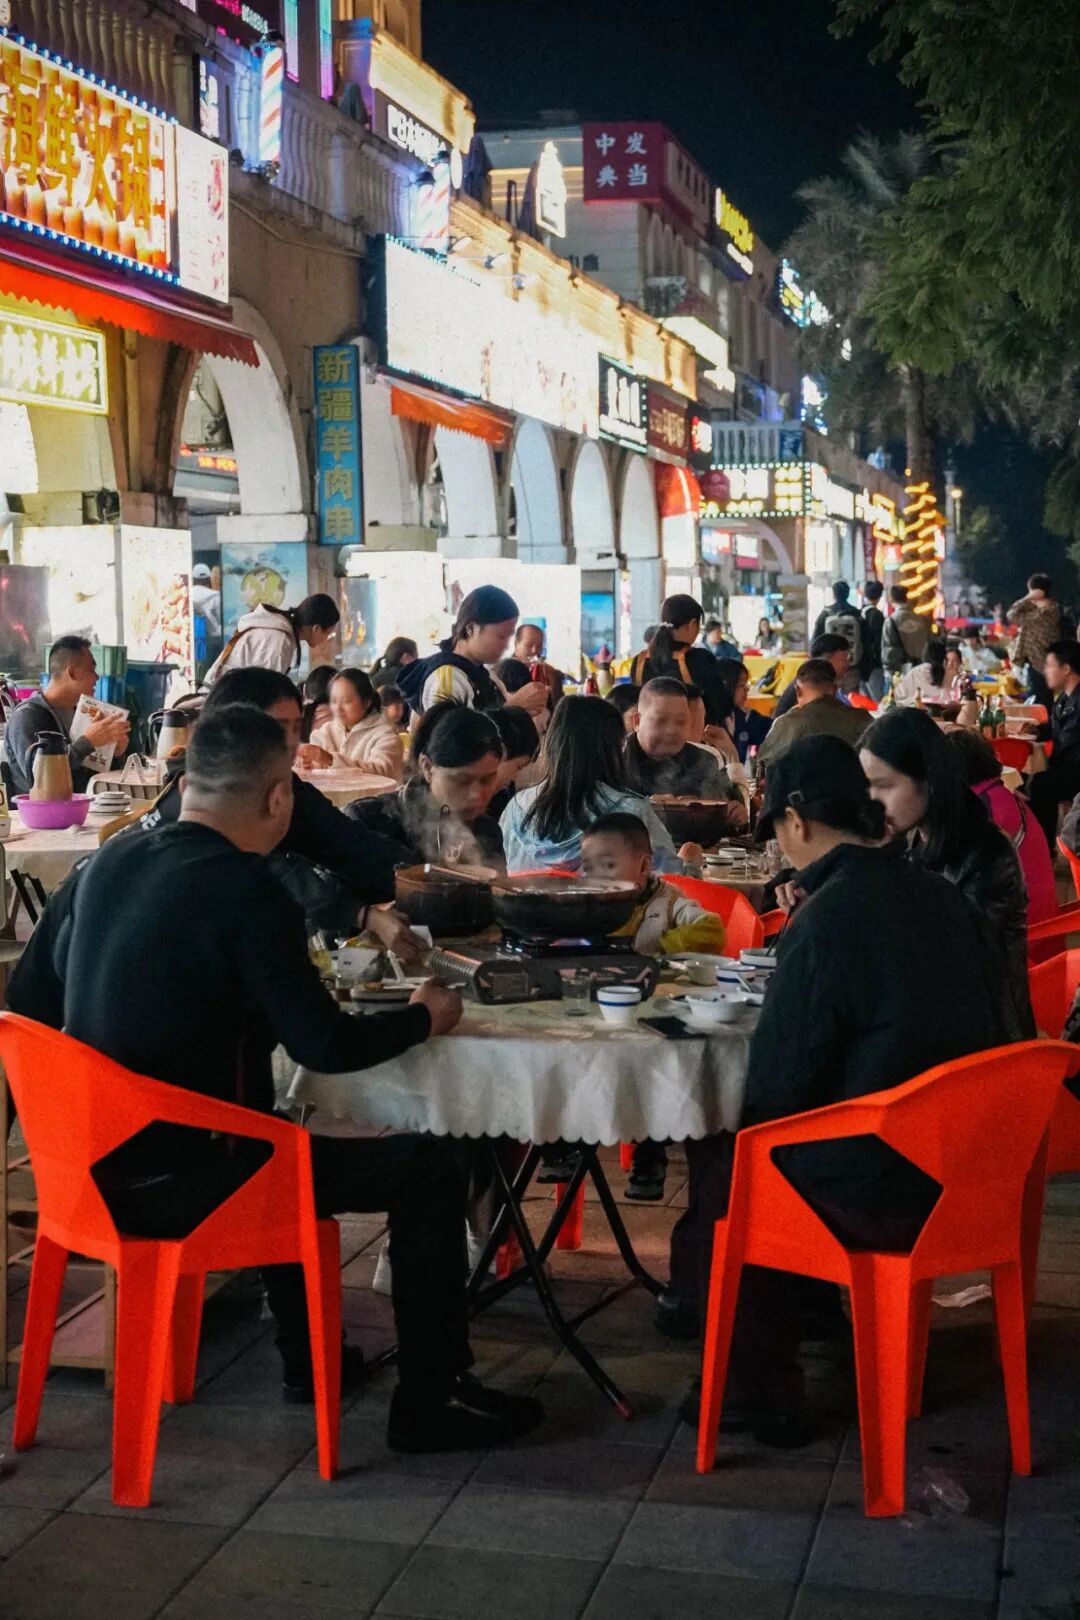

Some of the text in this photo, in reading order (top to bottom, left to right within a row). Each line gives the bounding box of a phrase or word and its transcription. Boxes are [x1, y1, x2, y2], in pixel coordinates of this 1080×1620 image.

[318, 351, 354, 541] 新疆羊肉串
